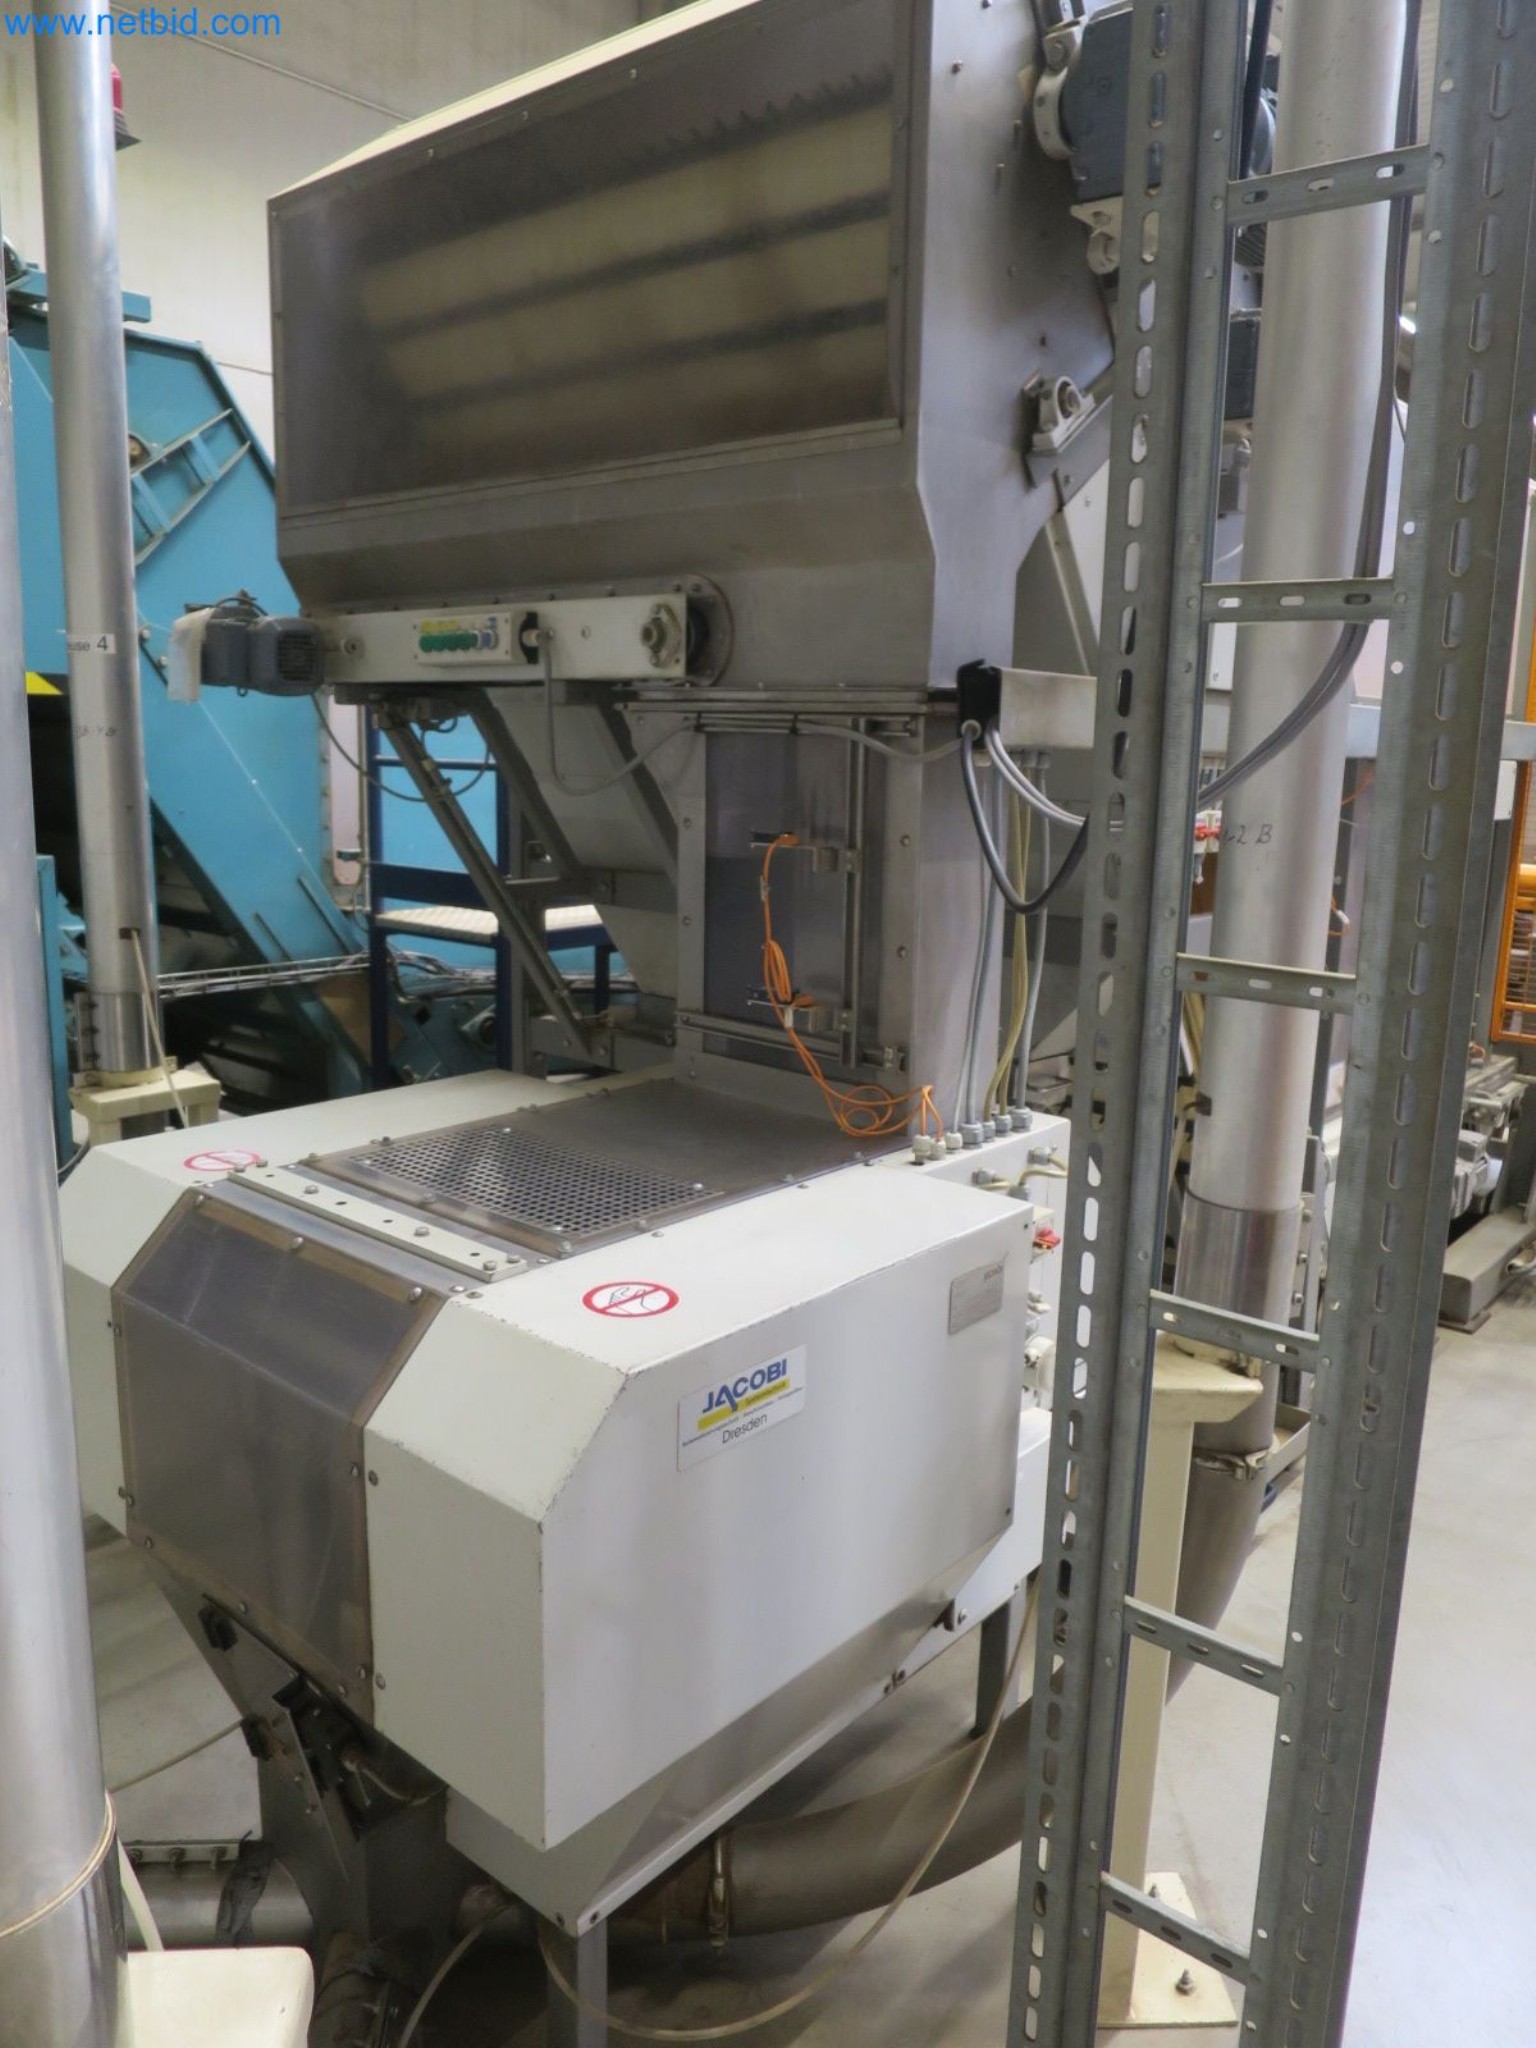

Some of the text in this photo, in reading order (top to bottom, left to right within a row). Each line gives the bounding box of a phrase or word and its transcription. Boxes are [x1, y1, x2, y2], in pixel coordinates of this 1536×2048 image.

[96, 634, 108, 652] 4
[702, 1359, 787, 1413] JACOBI
[722, 1414, 768, 1444] Dresden
